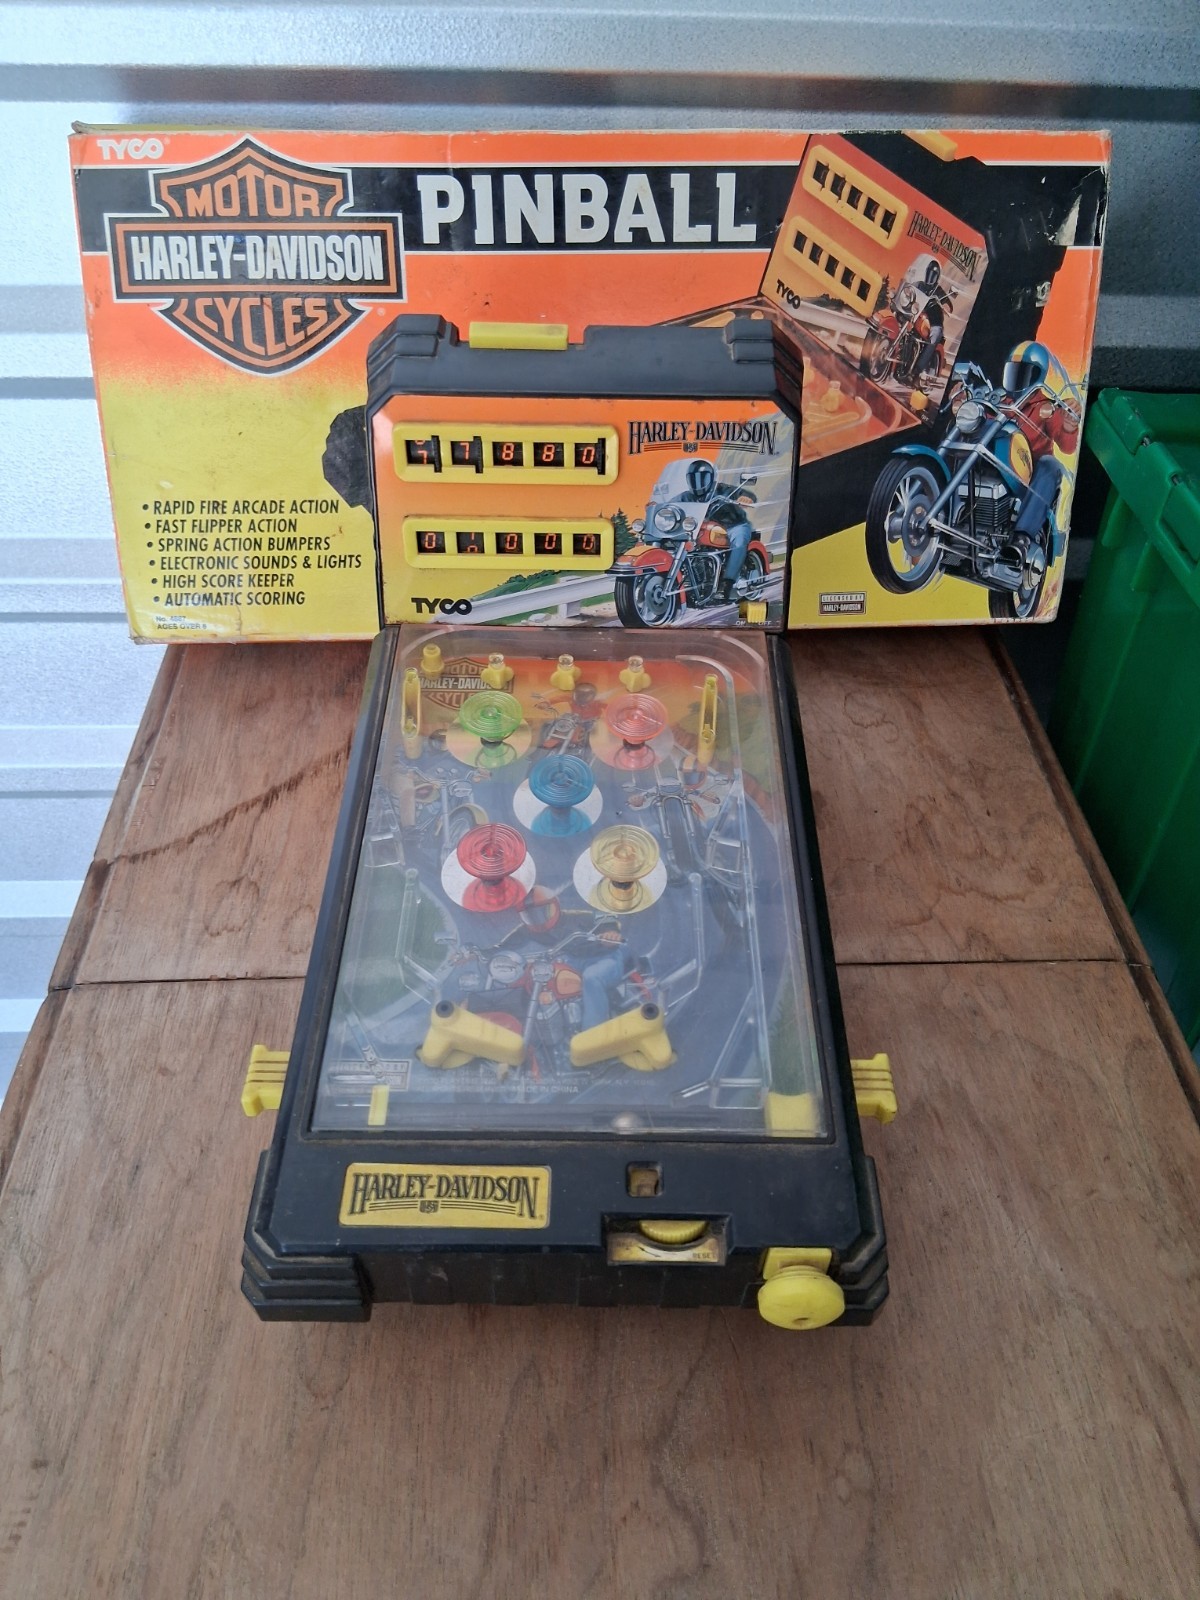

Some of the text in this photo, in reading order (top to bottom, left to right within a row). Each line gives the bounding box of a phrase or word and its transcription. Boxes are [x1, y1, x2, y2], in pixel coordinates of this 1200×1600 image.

[97, 138, 164, 160] TYCO
[185, 163, 320, 217] MOTOR
[416, 173, 757, 245] PINBALL
[130, 235, 384, 281] HARLEY-DAVIDSON
[907, 211, 983, 282] HARLEY-DAVIDSON
[776, 278, 801, 310] TYCO
[195, 298, 329, 356] CYCLES
[628, 420, 778, 455] HARLEY-DAVIDSON
[153, 499, 339, 515] RAPID FIRE ARCADE ACTION
[155, 518, 297, 533] FAST FLIPPER ACTION
[158, 536, 331, 552] SPRING ACTION BUMPERS
[160, 554, 362, 570] ELECTRONIC SOUNDS & LIGHTS
[163, 573, 294, 588] HIGH SCORE KEEPER
[164, 591, 306, 606] AUTOMATIC SCORING
[411, 597, 473, 616] TYCO
[348, 1173, 540, 1218] HARLEY-DAVIDSON
